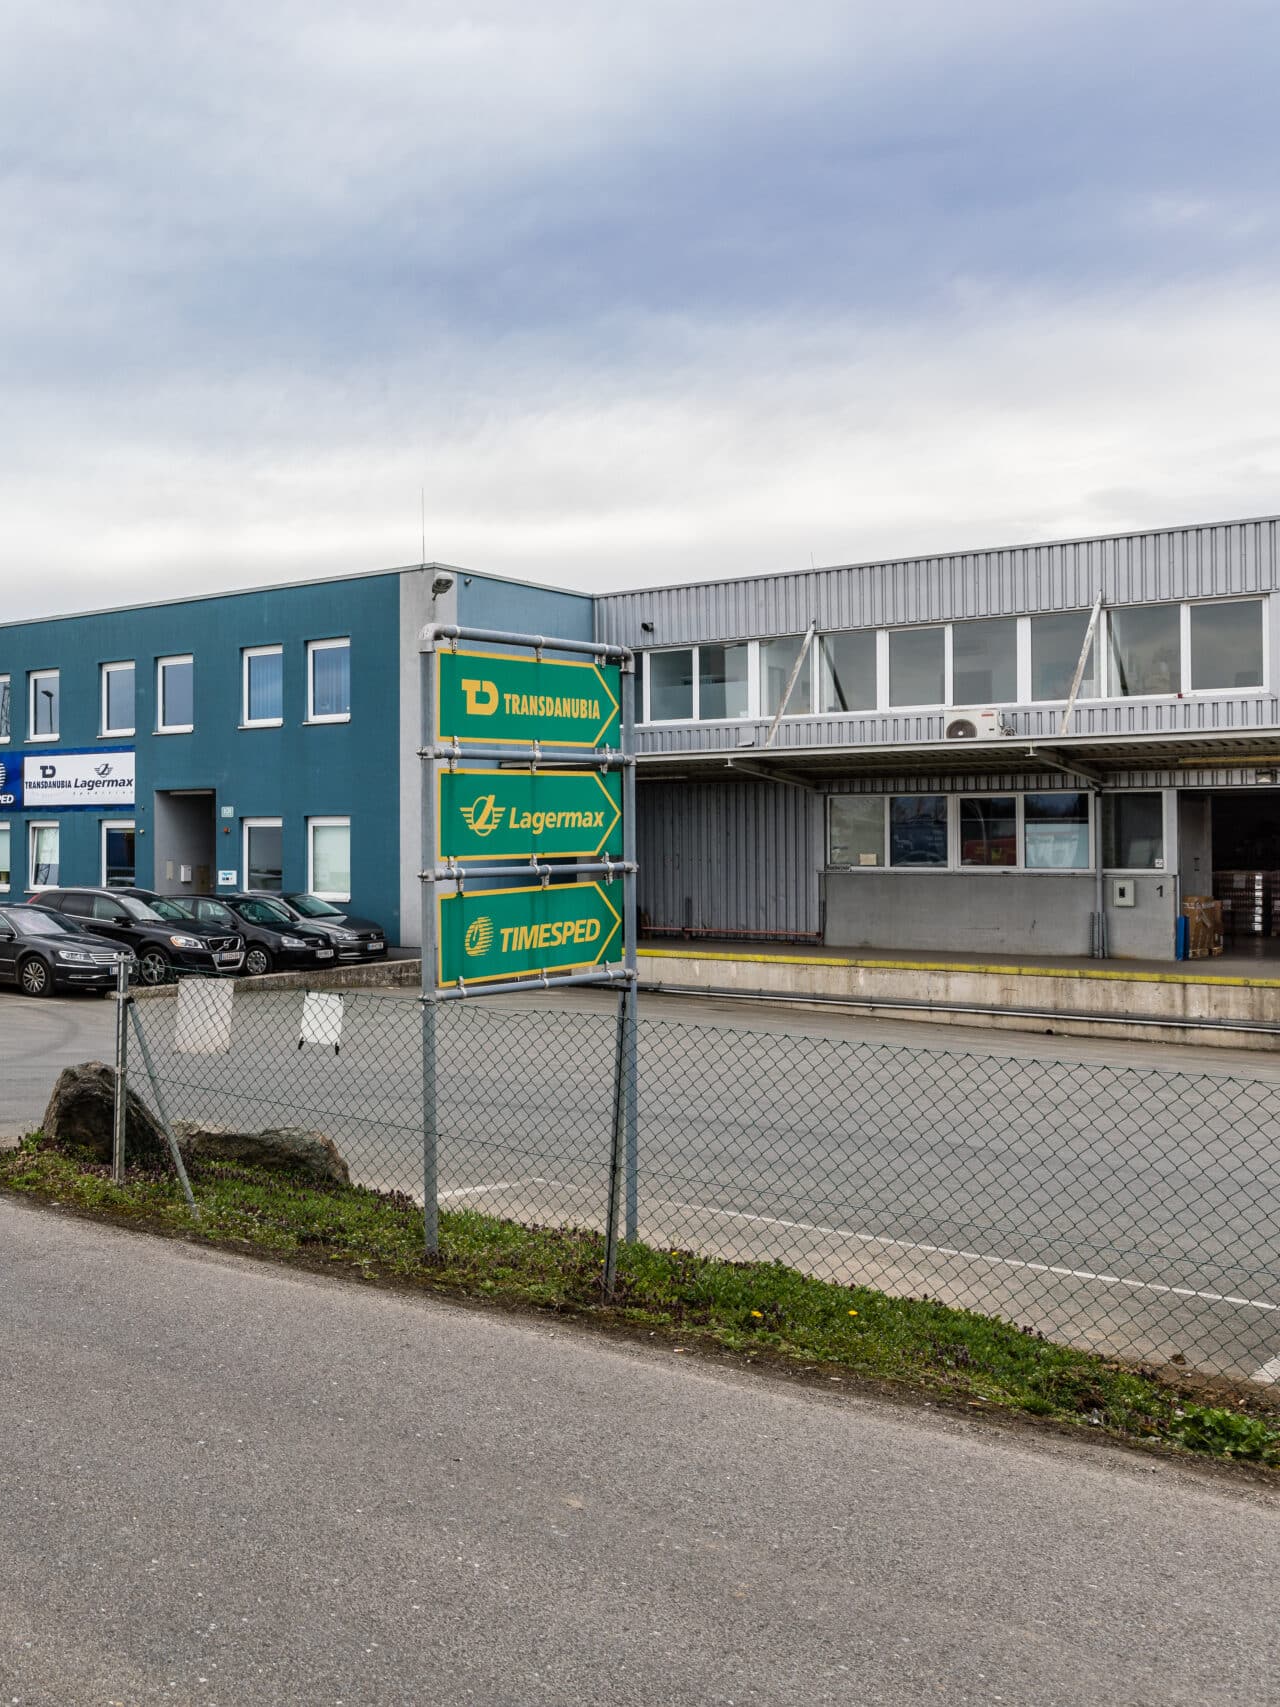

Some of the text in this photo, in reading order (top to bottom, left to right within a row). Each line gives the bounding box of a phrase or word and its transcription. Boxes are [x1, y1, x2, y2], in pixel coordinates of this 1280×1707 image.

[503, 693, 601, 720] TRANSDANUBIA
[25, 779, 72, 790] TRANSDANUBIA
[73, 778, 134, 791] Lagermax
[508, 807, 604, 836] Lagermax
[1156, 885, 1164, 897] 1
[500, 918, 601, 953] TIMESPED
